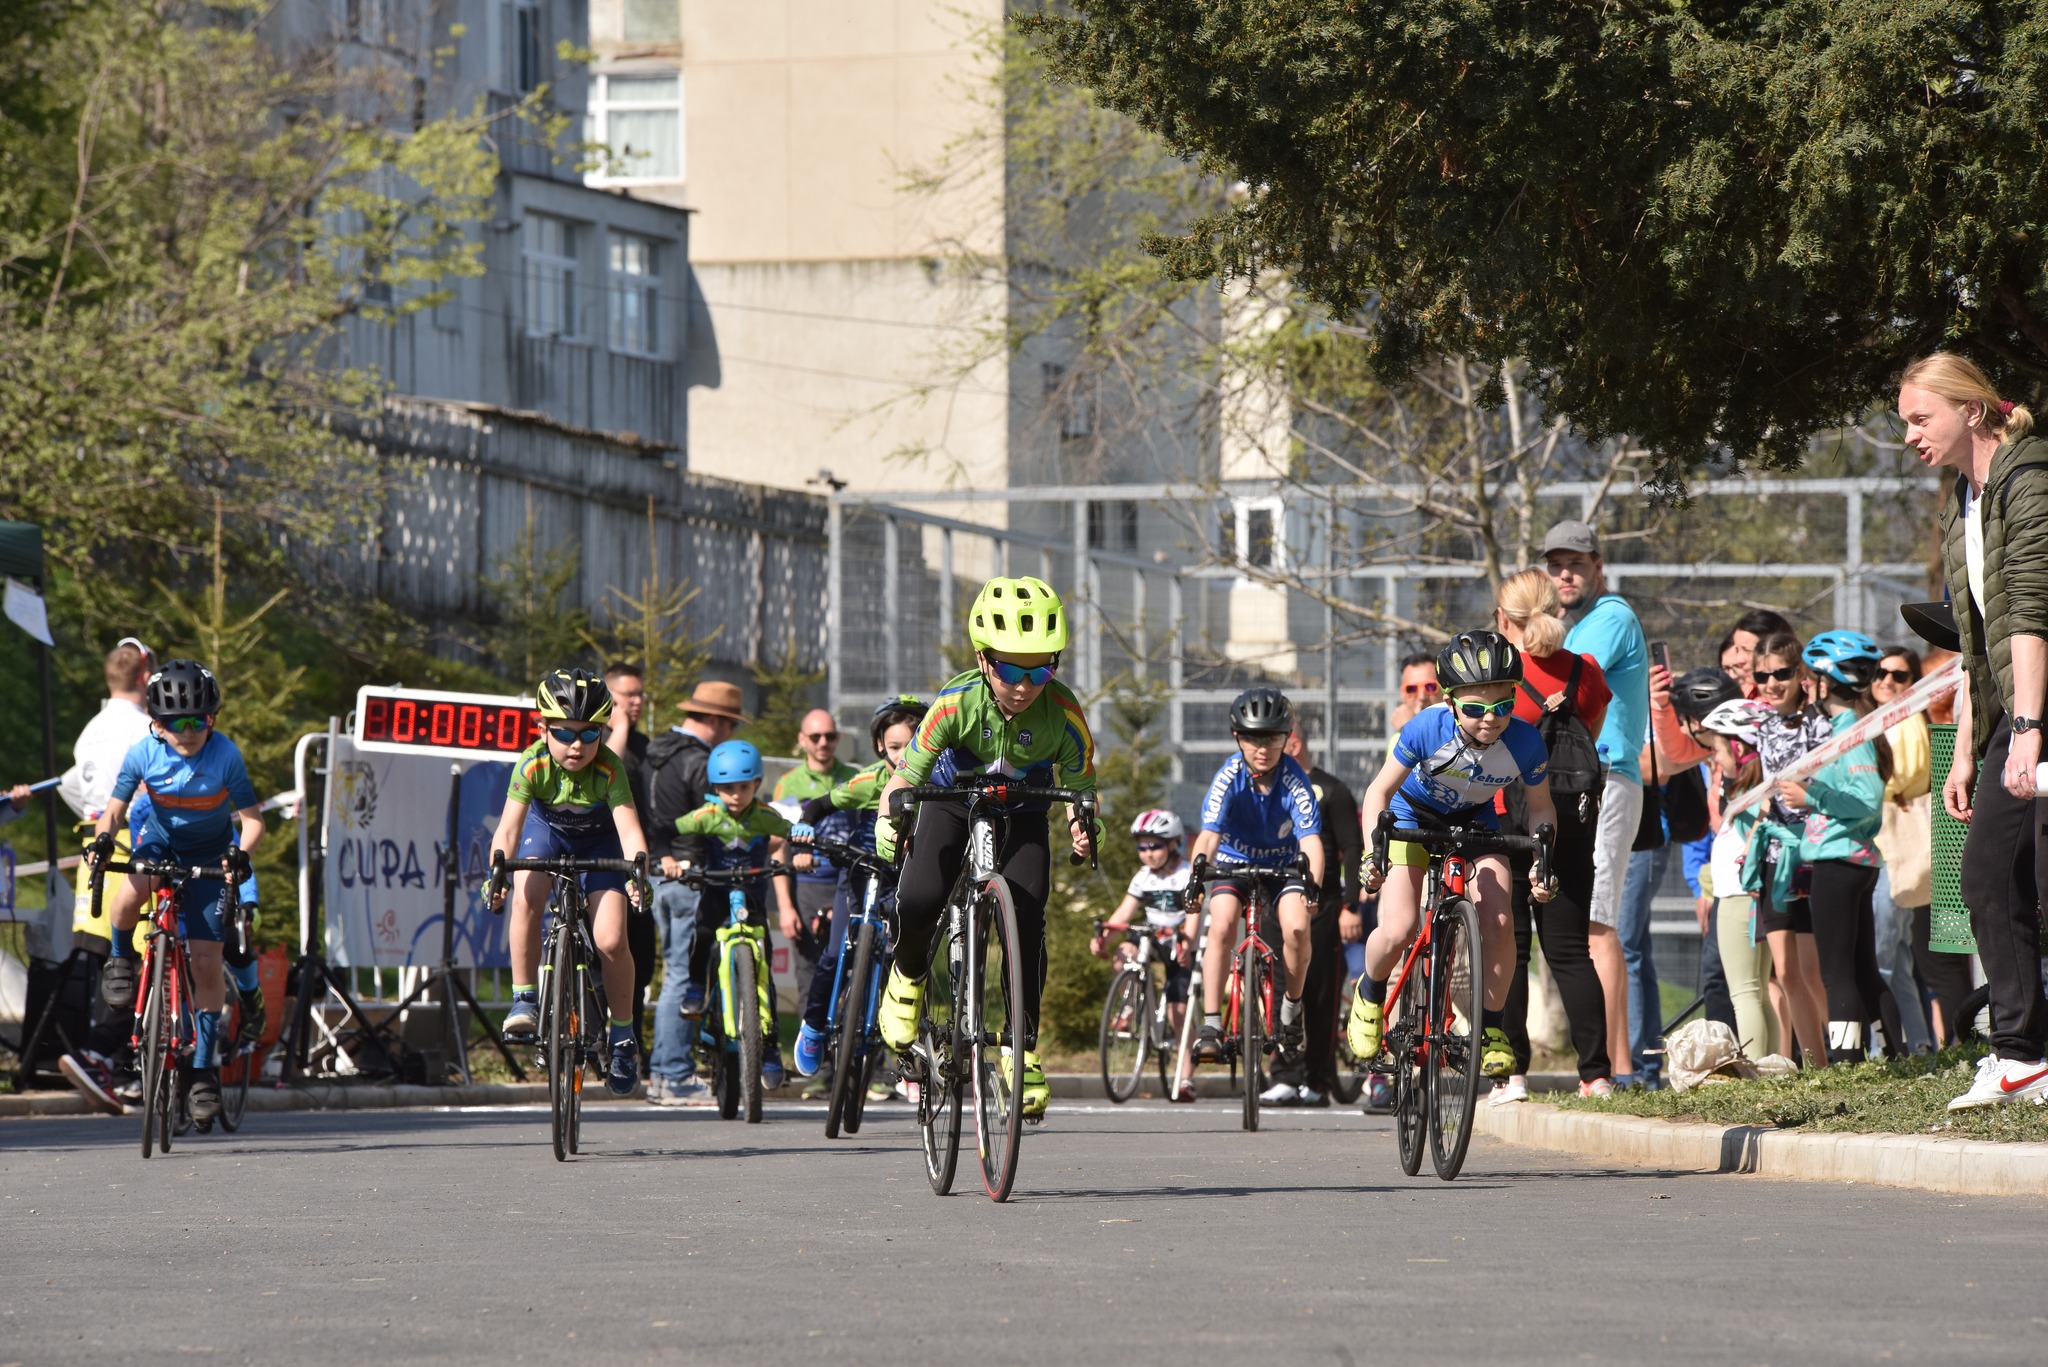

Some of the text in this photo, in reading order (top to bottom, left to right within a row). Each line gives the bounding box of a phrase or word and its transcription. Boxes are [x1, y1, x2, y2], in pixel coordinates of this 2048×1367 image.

[338, 838, 426, 890] CUPA
[982, 821, 995, 871] GIANT
[214, 887, 227, 916] VELO
